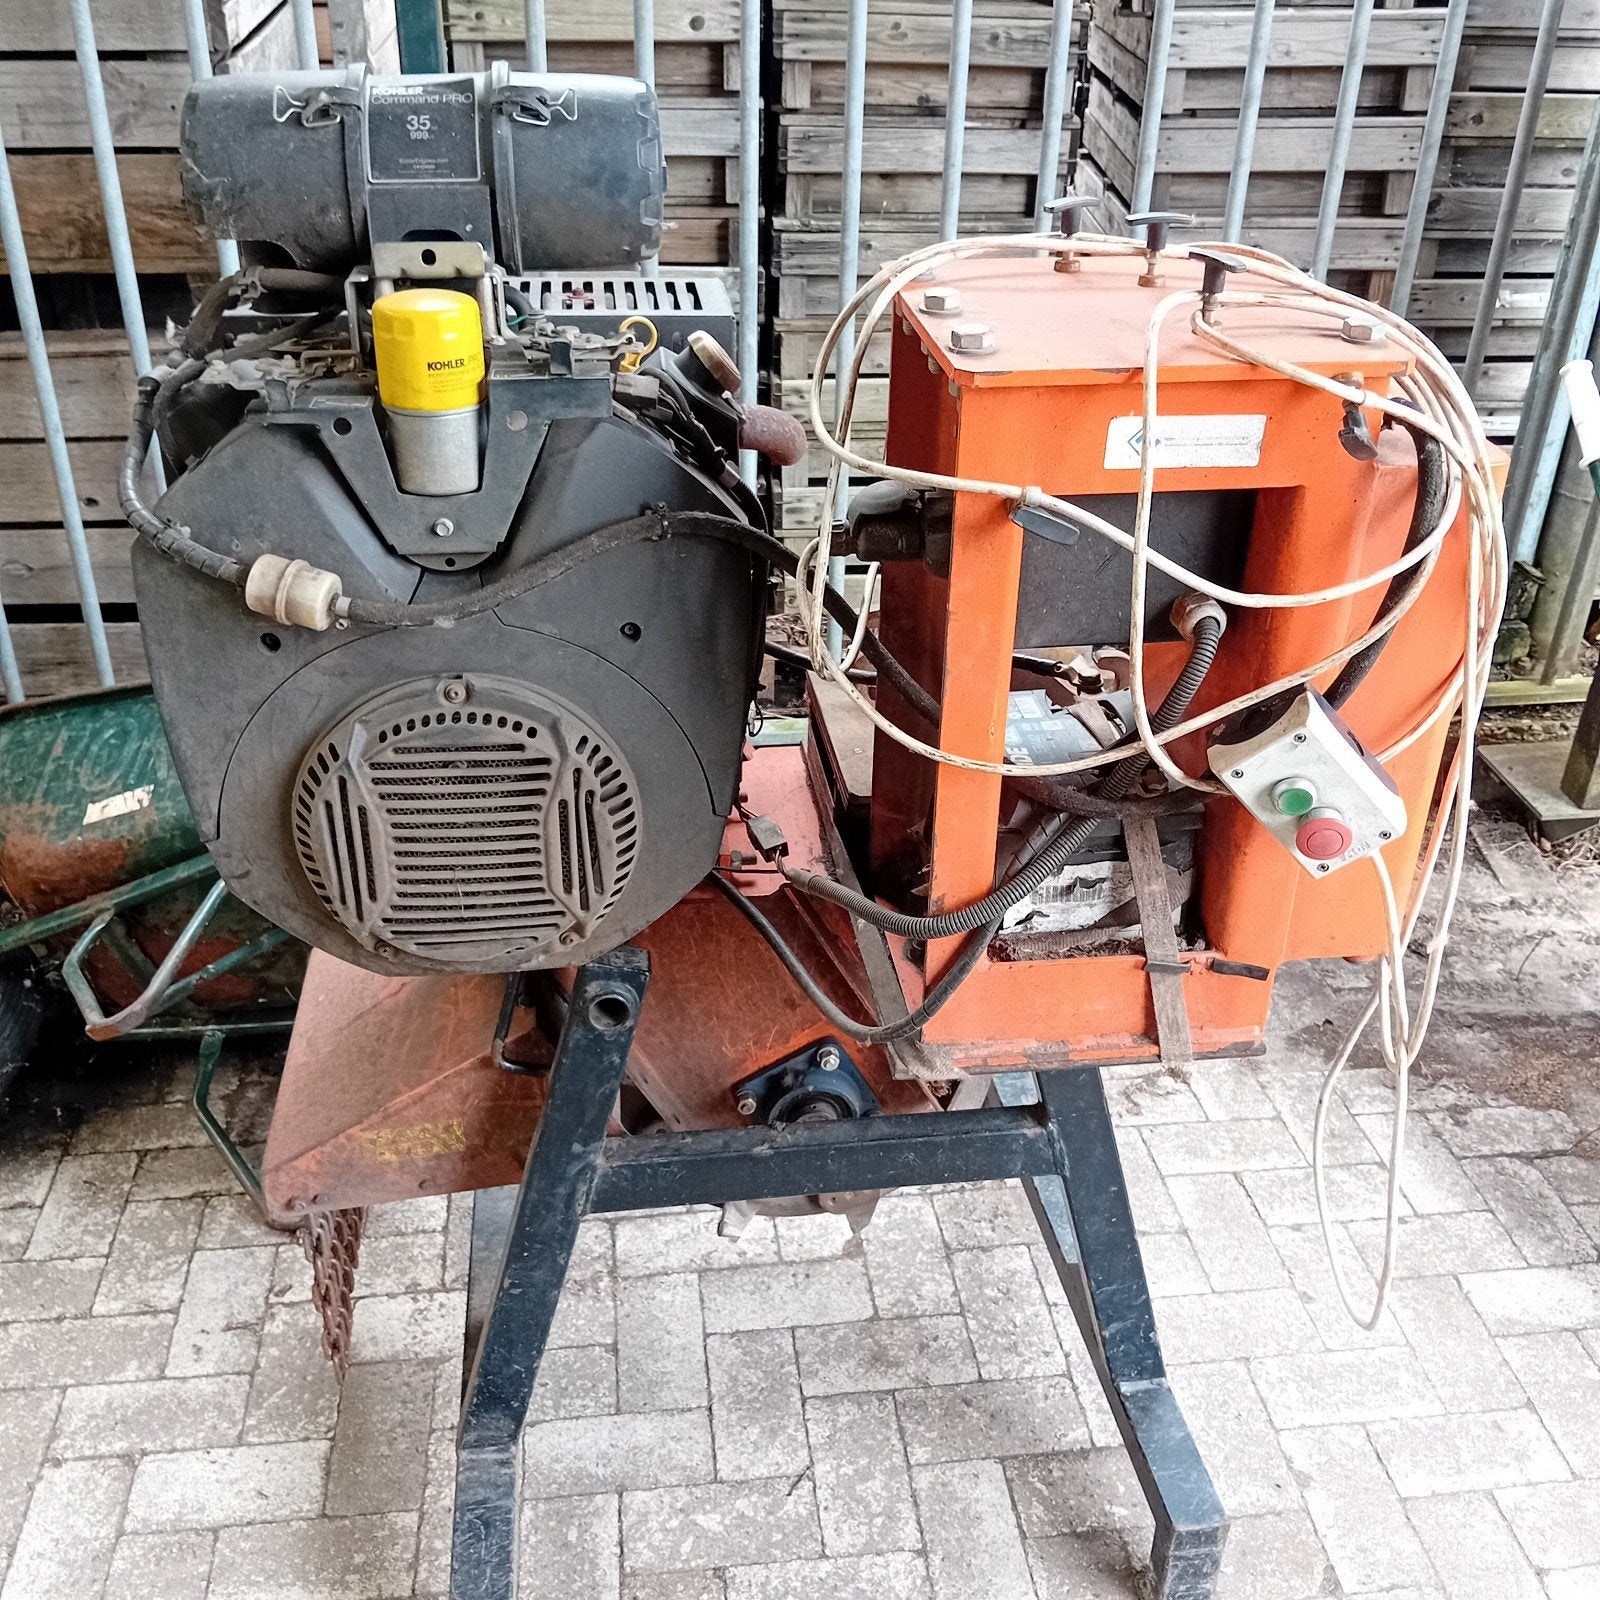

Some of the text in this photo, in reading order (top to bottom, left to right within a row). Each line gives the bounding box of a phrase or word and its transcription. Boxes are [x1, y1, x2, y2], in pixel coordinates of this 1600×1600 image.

[372, 86, 423, 95] KOHLER
[371, 92, 473, 105] Command PRO
[406, 115, 431, 130] 35
[427, 359, 465, 371] KOHLER
